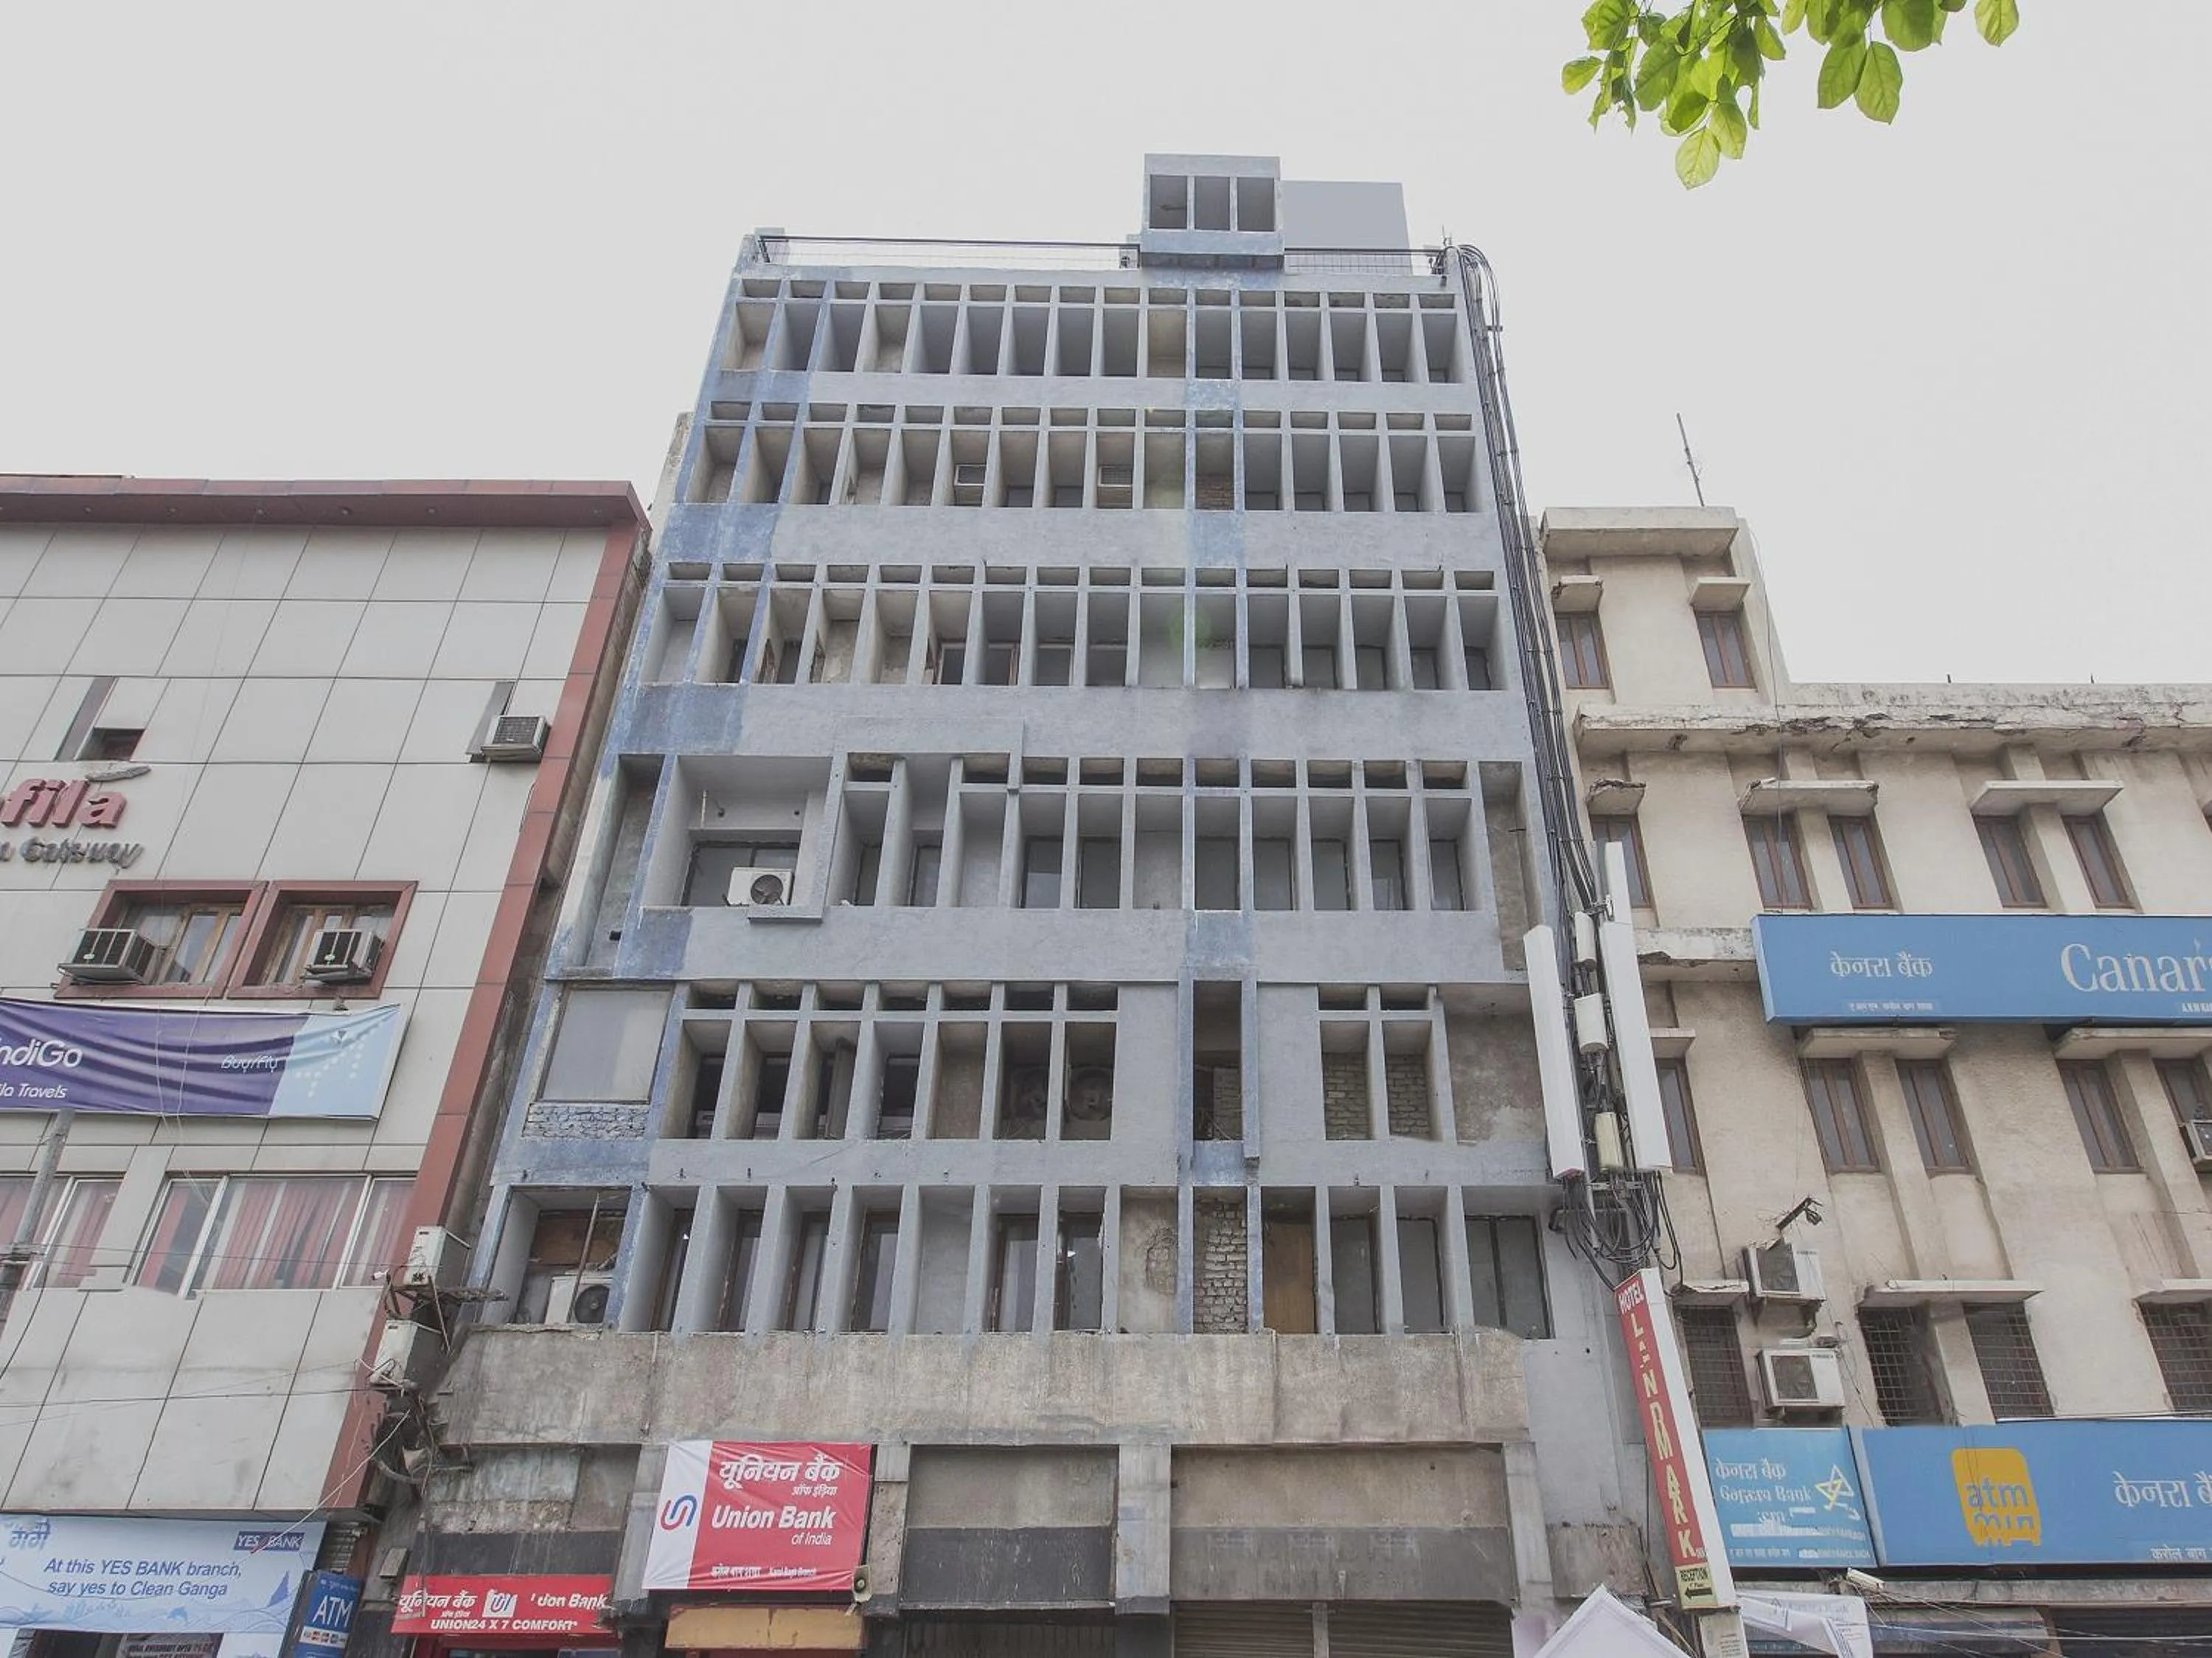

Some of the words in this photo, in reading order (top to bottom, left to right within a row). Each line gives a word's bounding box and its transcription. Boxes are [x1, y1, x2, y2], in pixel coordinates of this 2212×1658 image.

[0, 778, 127, 828] fila
[1830, 950, 1892, 977] केनरा
[2061, 943, 2212, 992] Canar
[0, 1038, 83, 1068] ndiGo
[18, 1082, 69, 1098] Travels
[1618, 1280, 1645, 1315] HOTEL
[719, 1454, 803, 1490] यूनियन
[804, 1452, 844, 1482] बैंक
[1964, 1475, 2030, 1508] atm
[2113, 1470, 2193, 1508] केनरा
[712, 1505, 775, 1529] Union
[778, 1505, 837, 1529] Bank
[237, 1535, 260, 1547] YES
[791, 1533, 804, 1546] of
[805, 1532, 832, 1546] India
[44, 1558, 63, 1573] At
[66, 1558, 95, 1574] this
[101, 1559, 133, 1575] YES
[136, 1561, 184, 1577] BANK
[187, 1561, 242, 1579] branch,
[49, 1581, 77, 1597] say
[79, 1582, 107, 1598] yes
[110, 1581, 127, 1595] to
[131, 1580, 174, 1596] Clean
[178, 1581, 228, 1600] Ganga
[568, 1592, 608, 1609] Bank
[312, 1594, 354, 1629] ATM
[488, 1619, 498, 1630] X
[501, 1619, 509, 1630] 7
